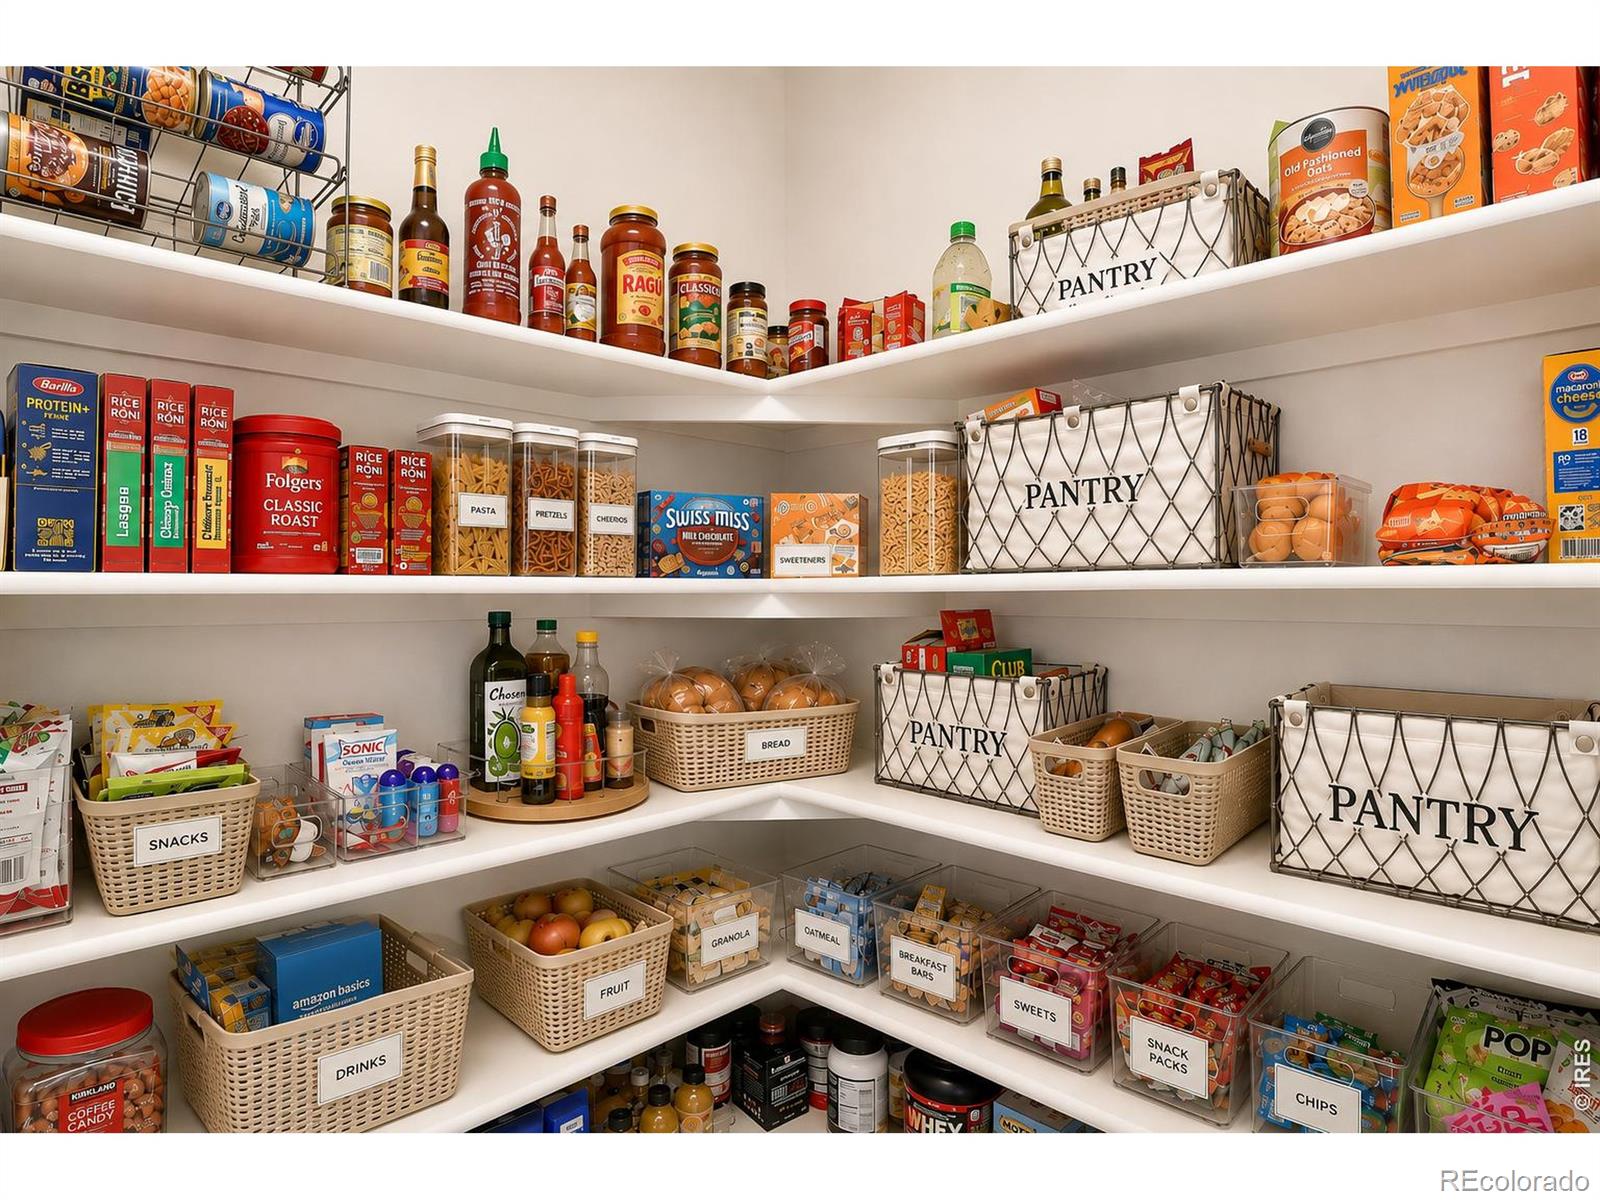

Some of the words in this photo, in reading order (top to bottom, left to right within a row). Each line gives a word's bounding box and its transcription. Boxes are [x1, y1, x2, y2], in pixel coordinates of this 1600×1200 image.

[1284, 162, 1301, 177] Old
[1307, 162, 1332, 177] Oats
[1058, 257, 1157, 300] PANTRY
[40, 380, 77, 393] Barilla
[26, 397, 90, 414] PROTEIN+
[111, 396, 140, 409] RICE
[157, 401, 185, 413] RICE
[201, 406, 228, 418] RICE
[1573, 428, 1587, 441] 18
[355, 452, 383, 463] RICE
[400, 456, 426, 467] RICE
[266, 473, 322, 493] Folgers
[1024, 474, 1144, 510] PANTRY
[263, 498, 323, 513] CLASSIC
[470, 506, 496, 515] PASTA
[535, 510, 568, 519] PRETZELS
[271, 514, 319, 527] ROAST
[666, 508, 710, 529] SWISS
[779, 556, 826, 564] SWEETENERS
[991, 660, 1025, 677] CLUB
[343, 741, 383, 756] SONIC
[761, 738, 791, 749] BREAD
[910, 720, 1007, 758] PANTRY
[1328, 784, 1539, 852] PANTRY
[149, 832, 208, 851] SNACKS
[711, 929, 751, 948] GRANOLA
[804, 926, 841, 946] OATMEAL
[898, 949, 948, 973] BREAKFAST
[911, 967, 935, 981] BARS
[292, 989, 336, 1010] amazon
[338, 979, 370, 996] basics
[600, 980, 630, 999] FRUIT
[1013, 1000, 1057, 1023] SWEETS
[1147, 1038, 1190, 1061] SNACK
[1483, 1024, 1552, 1063] POP
[336, 1054, 386, 1081] DRINKS
[1149, 1053, 1188, 1075] PACKS
[67, 1099, 116, 1122] COFFEE
[1295, 1092, 1338, 1116] CHIPS
[67, 1109, 115, 1132] CANDY
